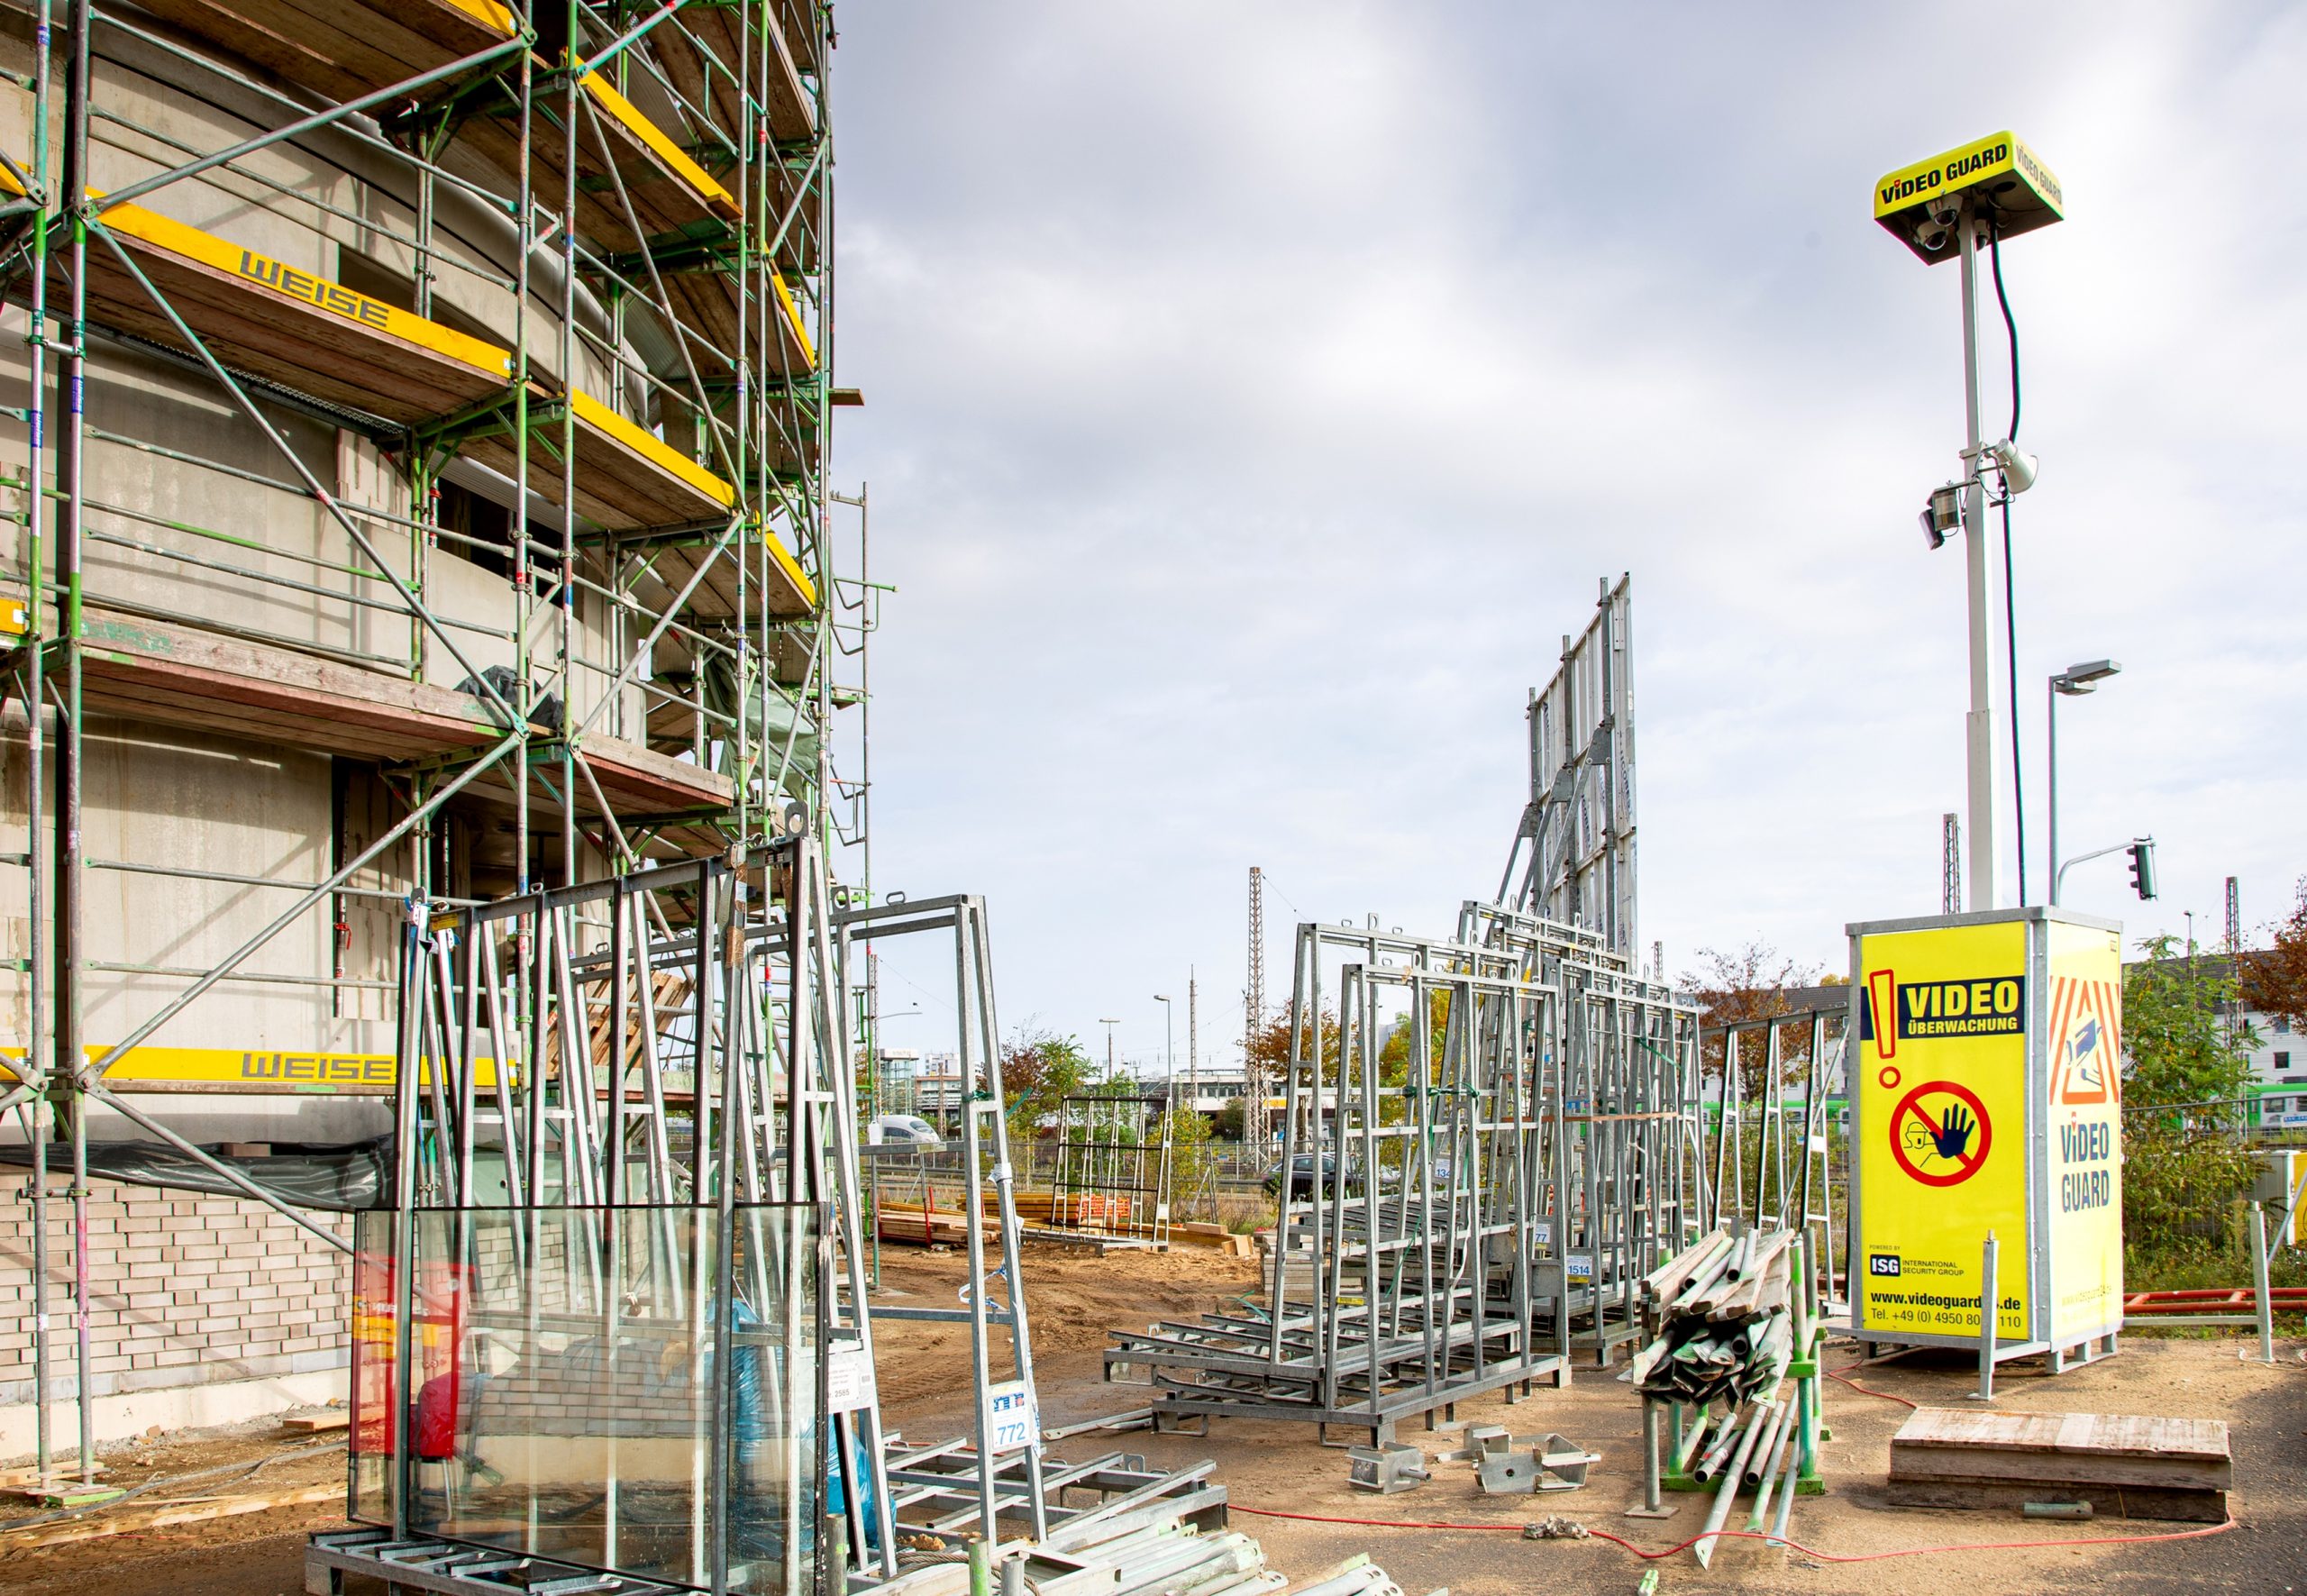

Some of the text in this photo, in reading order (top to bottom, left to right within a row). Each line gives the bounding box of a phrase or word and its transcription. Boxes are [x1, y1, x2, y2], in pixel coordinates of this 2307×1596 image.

[1946, 143, 2007, 181] GUARD
[2039, 170, 2062, 205] GUARD
[240, 250, 390, 328] WEISE
[1906, 980, 2019, 1018] VIDEO
[1908, 1017, 2018, 1035] ÜBERWACHUNG
[242, 1053, 392, 1081] WEISE
[2061, 1170, 2110, 1213] GUARD
[1567, 1265, 1590, 1274] 1514
[1871, 1257, 1900, 1273] ISG
[1902, 1260, 1958, 1269] INTERNATIONAL
[1902, 1267, 1965, 1276] SECURITY GROUP
[1871, 1291, 2021, 1310] www.videoguard.de
[1871, 1308, 1889, 1320] Tel.
[1892, 1309, 1914, 1322] +49
[1917, 1310, 1931, 1324] (0)
[1935, 1312, 1963, 1326] 4950
[1999, 1316, 2021, 1328] 110
[997, 1421, 1026, 1445] 772
